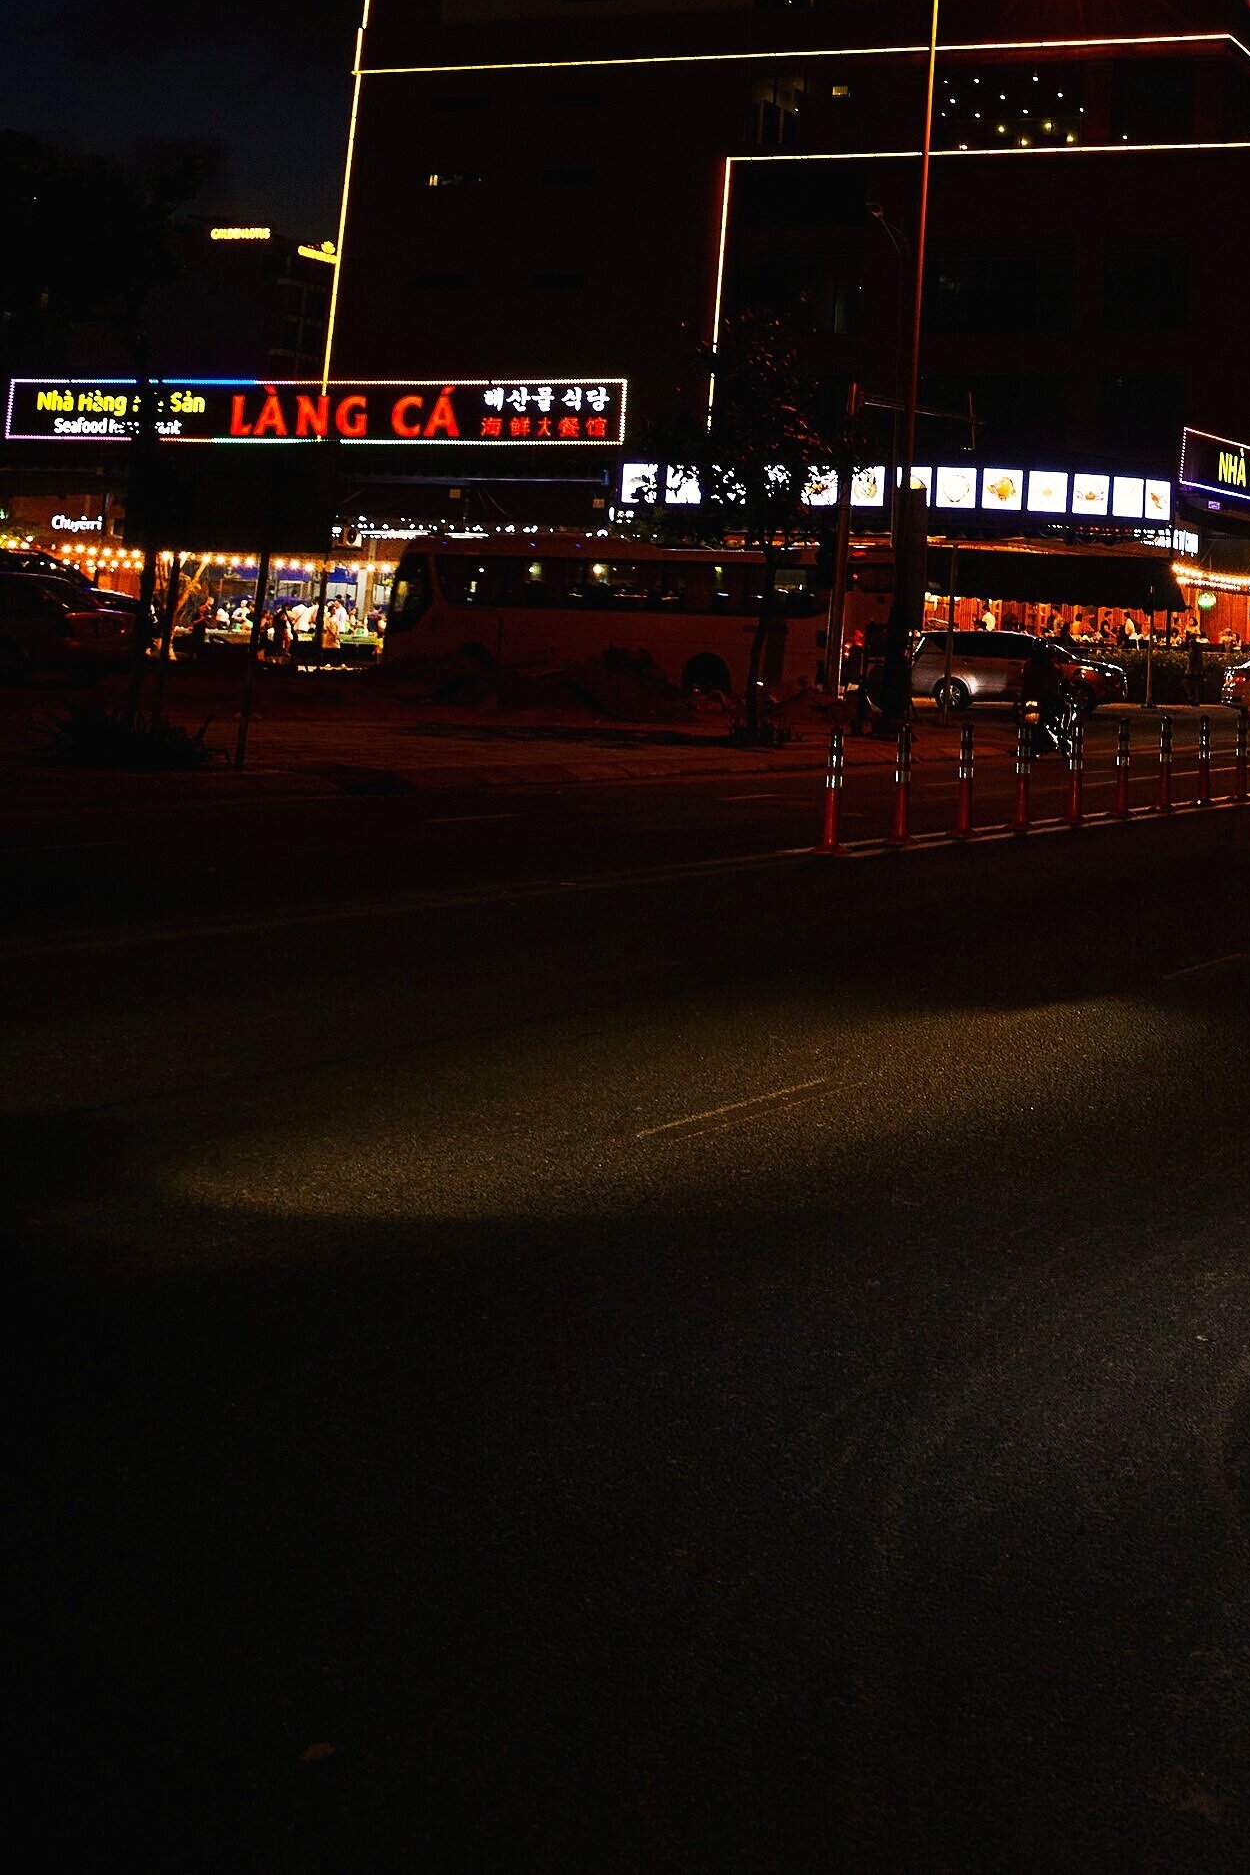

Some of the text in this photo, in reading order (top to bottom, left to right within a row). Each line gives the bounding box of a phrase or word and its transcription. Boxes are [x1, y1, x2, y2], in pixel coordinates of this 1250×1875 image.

[37, 389, 74, 412] Nhà
[77, 389, 127, 416] Hàng
[229, 385, 460, 437] LÀNG CÁ
[483, 386, 611, 413] 해산물 식당
[54, 417, 107, 434] Seafood
[1218, 448, 1246, 487] NHÀ
